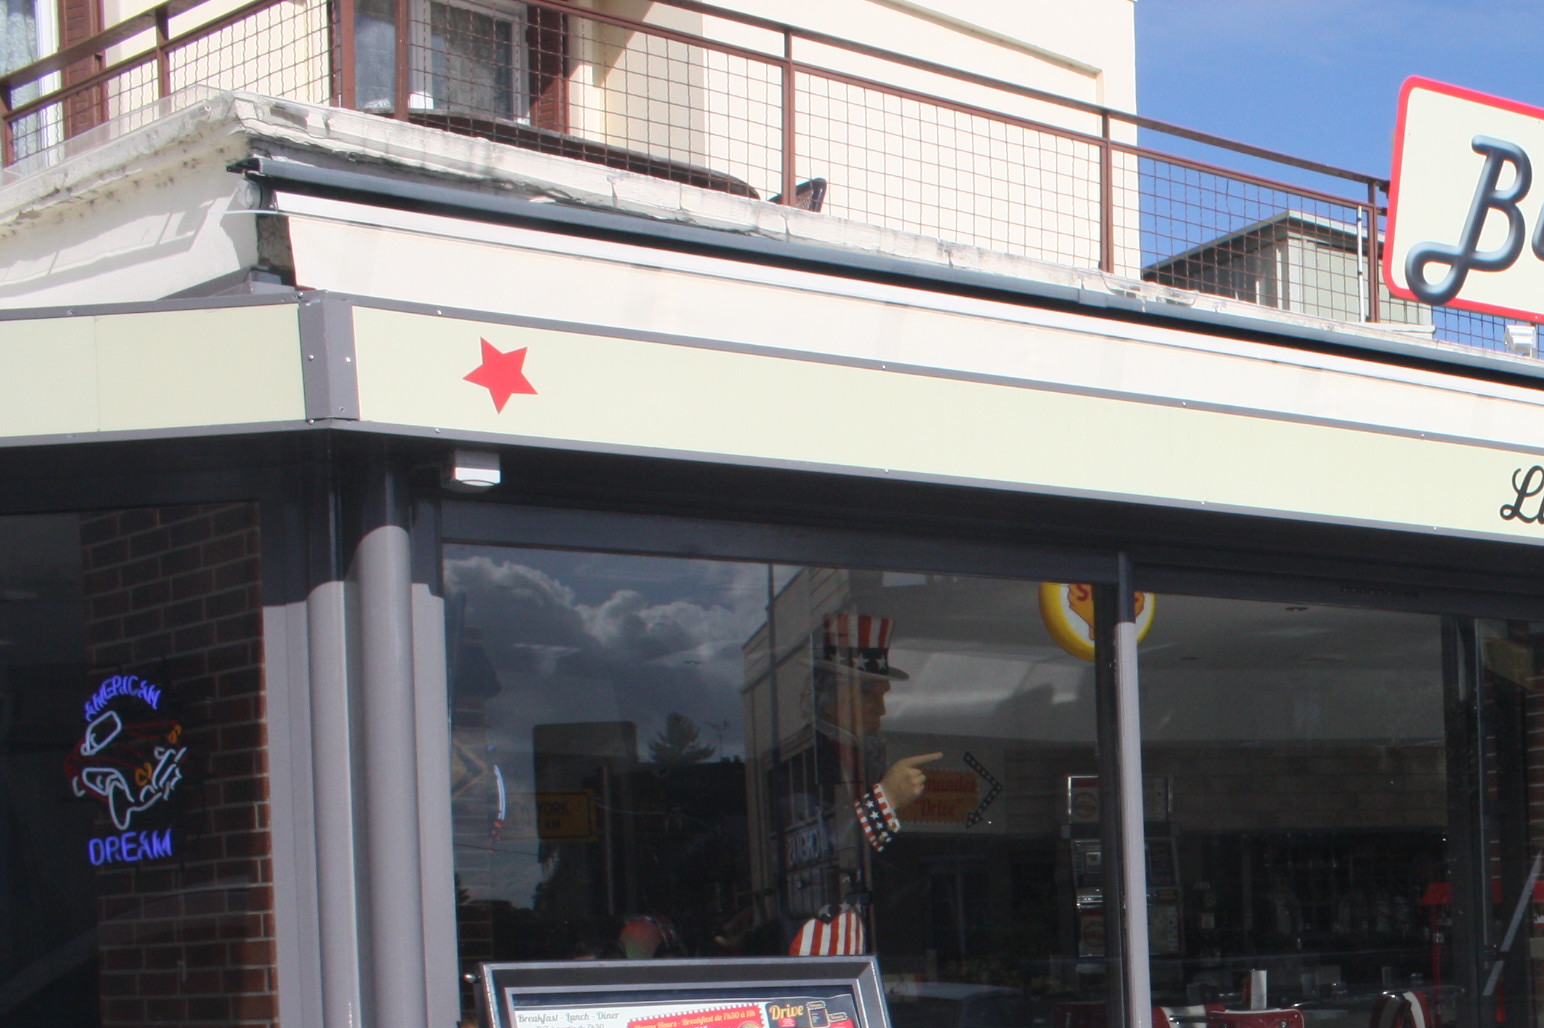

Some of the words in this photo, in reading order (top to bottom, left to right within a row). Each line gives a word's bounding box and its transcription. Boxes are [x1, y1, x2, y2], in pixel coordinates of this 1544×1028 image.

[84, 674, 162, 722] AMERICAN
[88, 828, 173, 866] DREAM
[517, 1014, 558, 1025] Breakfast
[566, 1012, 590, 1024] Lunch
[597, 1011, 620, 1020] Diner
[769, 1004, 804, 1020] Drive
